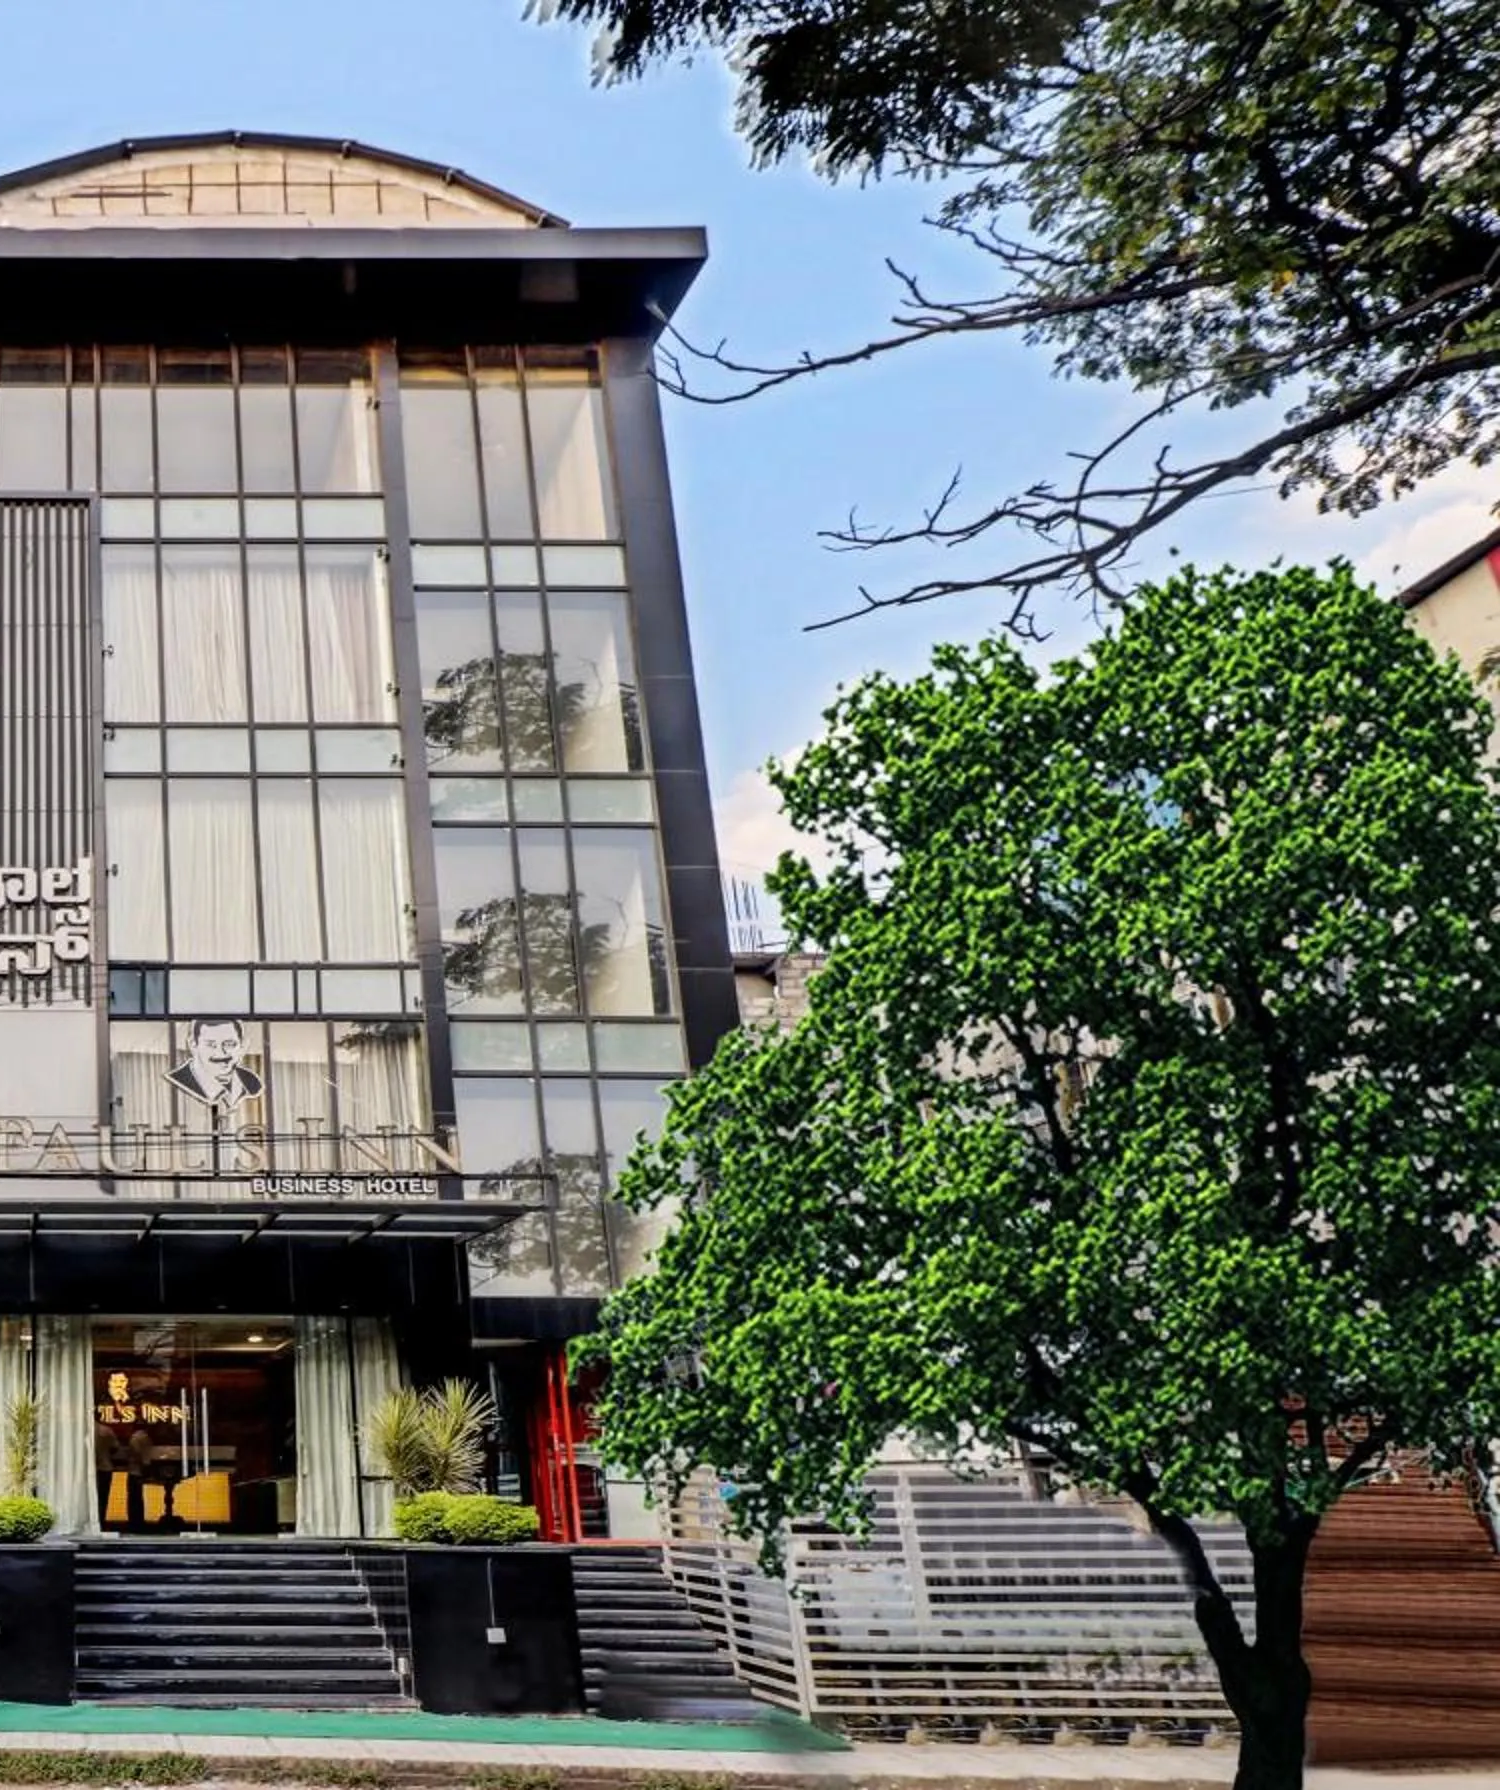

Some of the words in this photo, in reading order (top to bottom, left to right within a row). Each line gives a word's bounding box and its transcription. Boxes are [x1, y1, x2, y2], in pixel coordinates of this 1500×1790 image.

[296, 1116, 463, 1175] INN
[252, 1176, 355, 1195] BUSINESS
[366, 1176, 436, 1195] HOTEL
